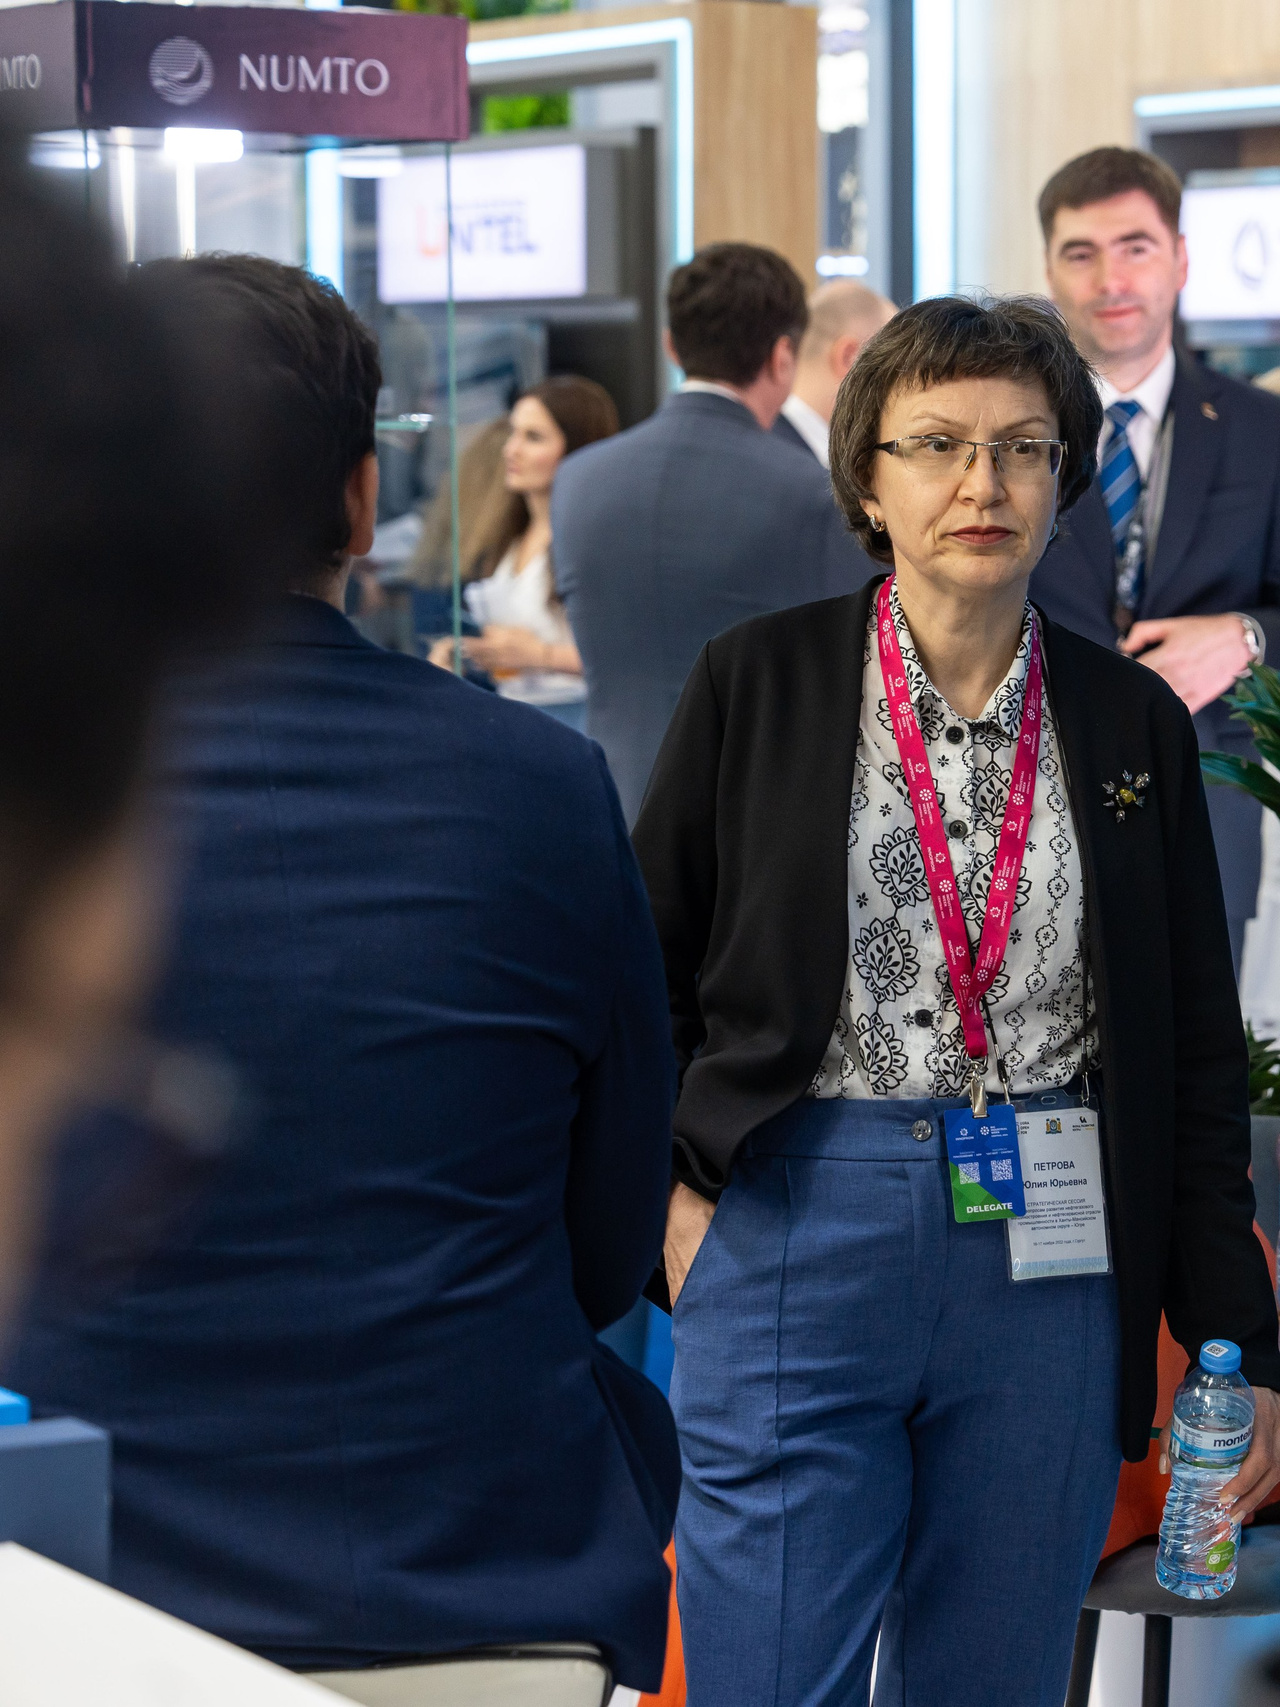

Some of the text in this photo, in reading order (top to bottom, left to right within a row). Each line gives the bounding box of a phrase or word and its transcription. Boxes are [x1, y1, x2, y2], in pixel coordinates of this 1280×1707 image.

[240, 53, 390, 96] NUMTO
[907, 758, 916, 781] INNOPROM
[927, 846, 936, 872] INNOPROM
[1000, 901, 1008, 927] INNOPROM
[948, 940, 956, 966] INNOPROM
[1034, 1161, 1075, 1171] ПЕТРОВА
[1024, 1179, 1087, 1189] Юлия Юрьевна
[967, 1202, 1013, 1213] DELEGATE
